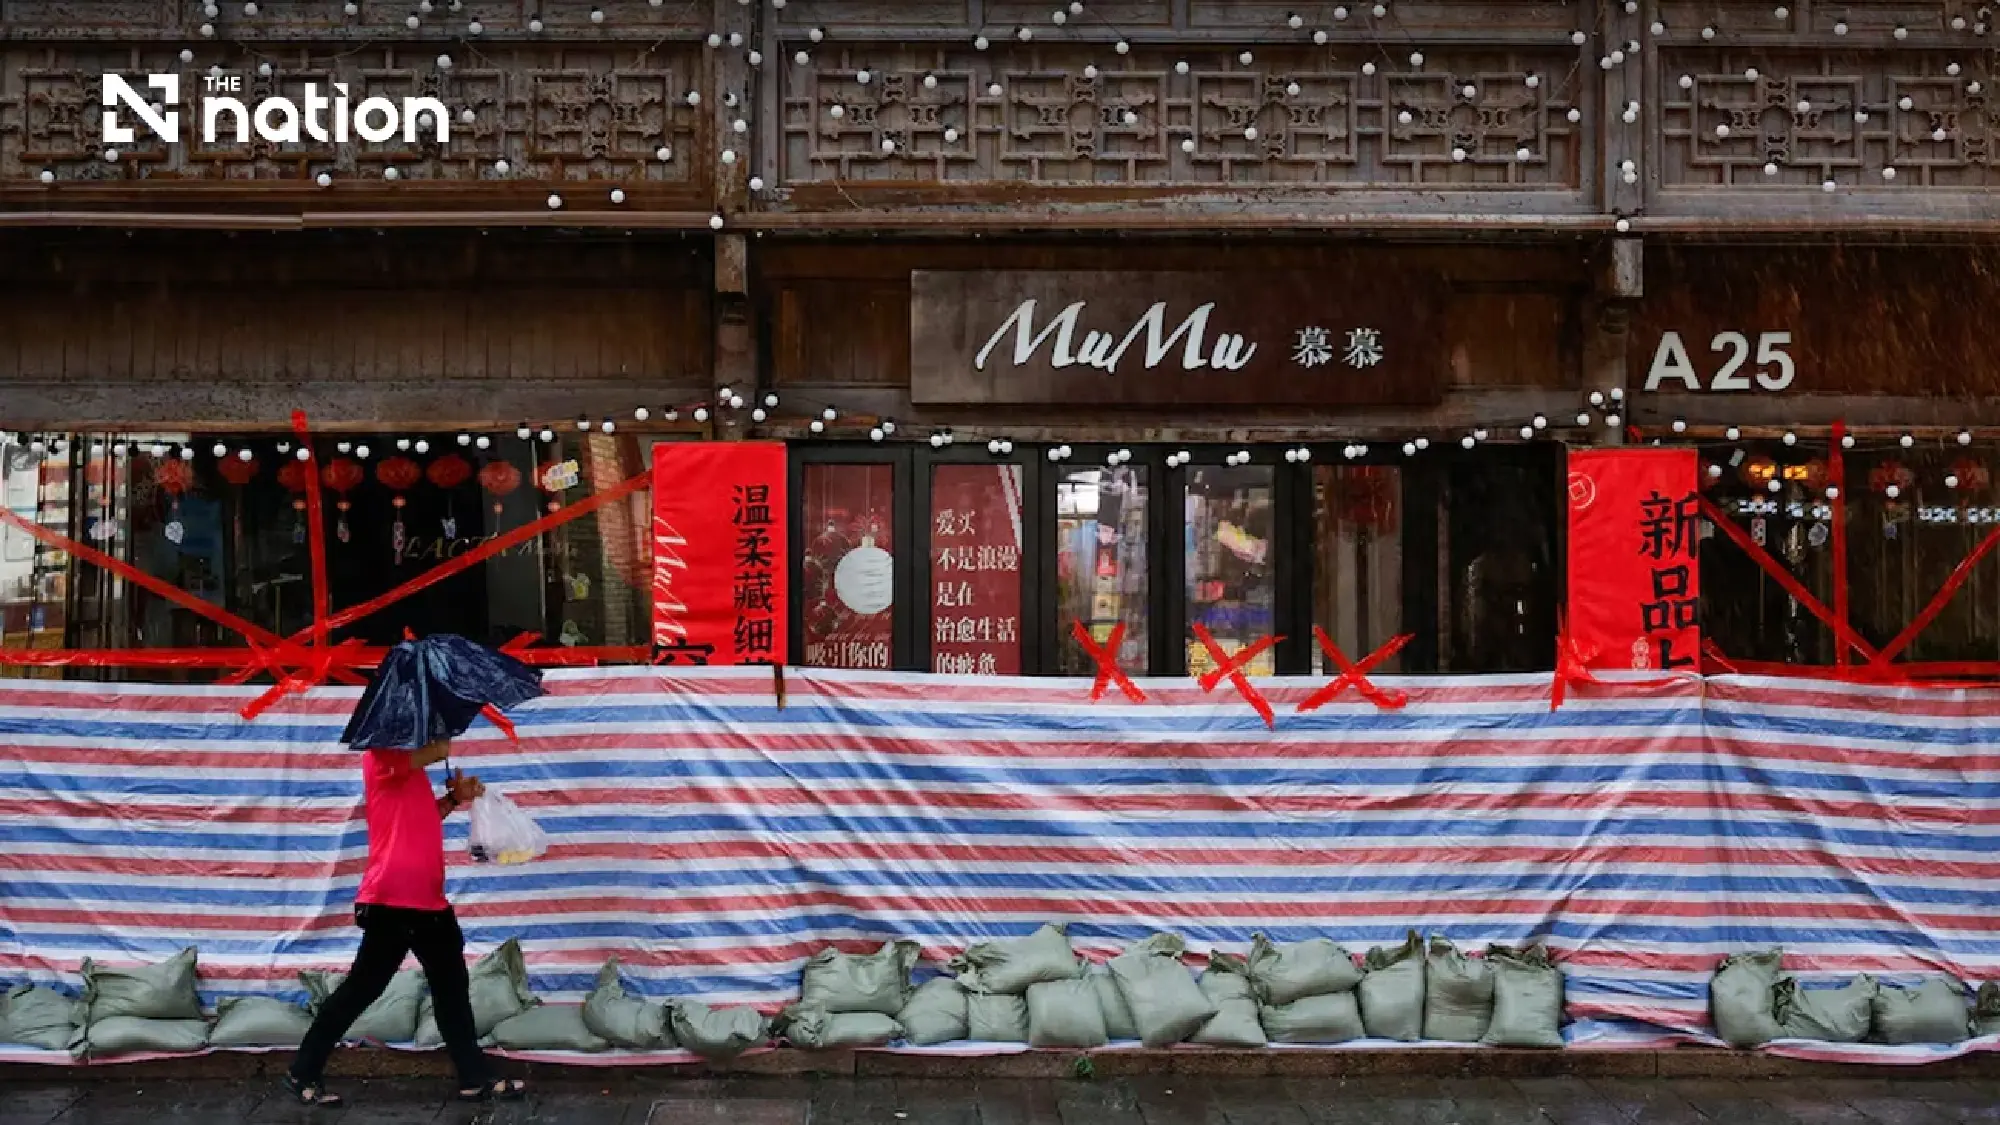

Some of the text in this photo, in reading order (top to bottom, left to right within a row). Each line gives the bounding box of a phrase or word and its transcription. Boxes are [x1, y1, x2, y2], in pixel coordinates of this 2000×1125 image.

[975, 298, 1384, 373] MuMu 慕慕
[936, 545, 1018, 571] 不是浪漫
[730, 483, 775, 665] 温柔藏细
[936, 581, 973, 607] 是在
[936, 616, 1016, 643] 治愈生活
[805, 642, 889, 669] 吸引你的
